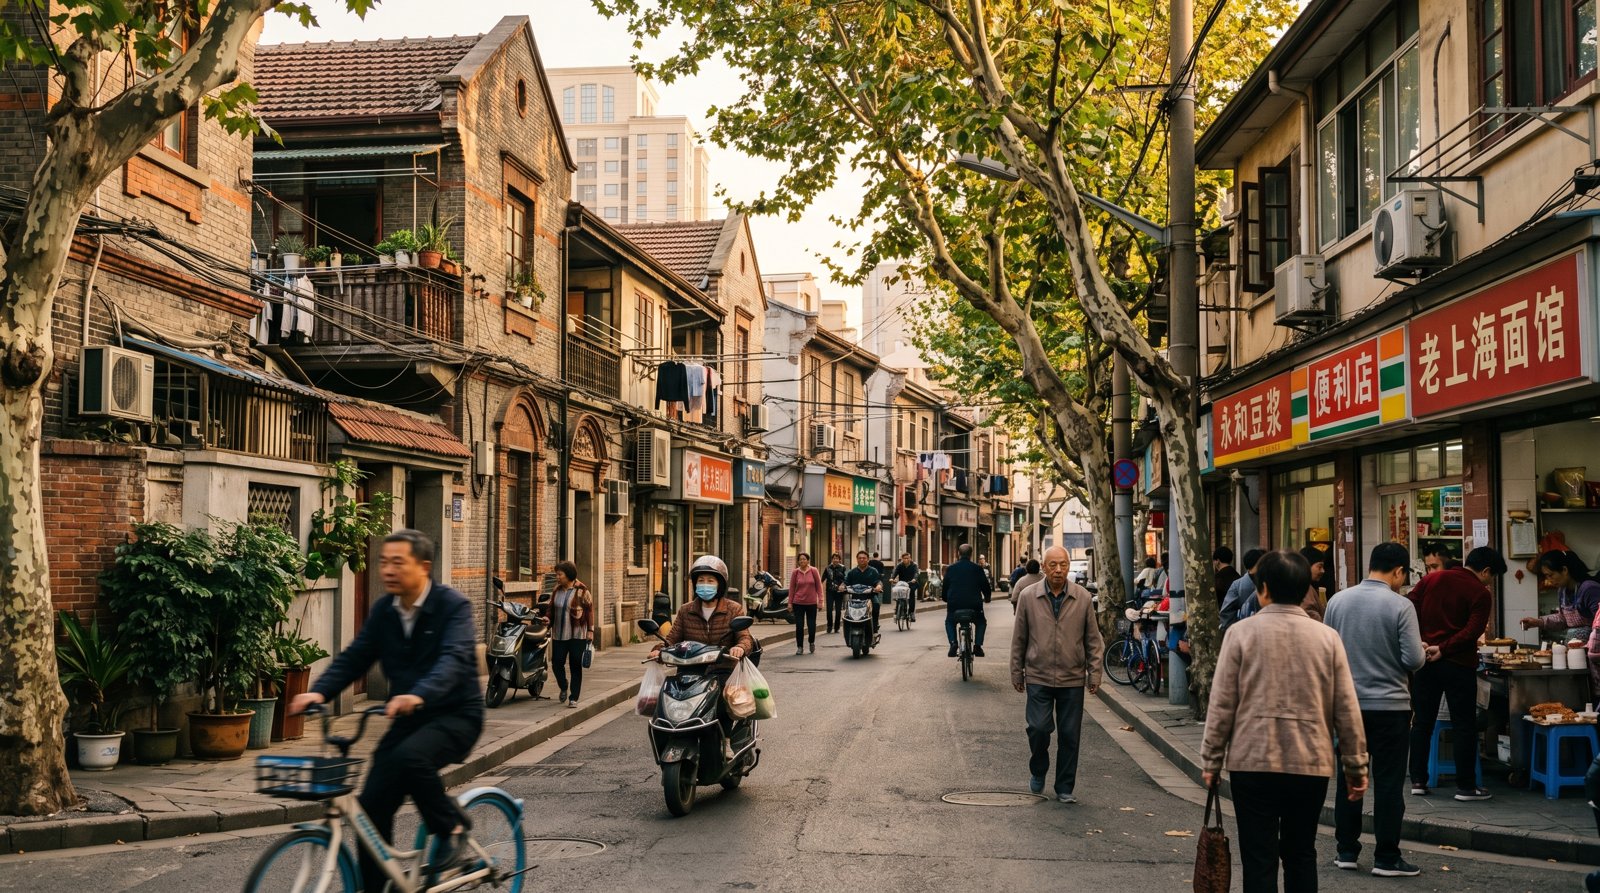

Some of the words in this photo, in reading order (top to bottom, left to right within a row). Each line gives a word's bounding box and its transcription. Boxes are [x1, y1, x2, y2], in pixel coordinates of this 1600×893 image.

[1418, 285, 1565, 395] 老上海面馆
[1220, 386, 1282, 450] 永和豆浆
[1313, 352, 1373, 418] 便利店
